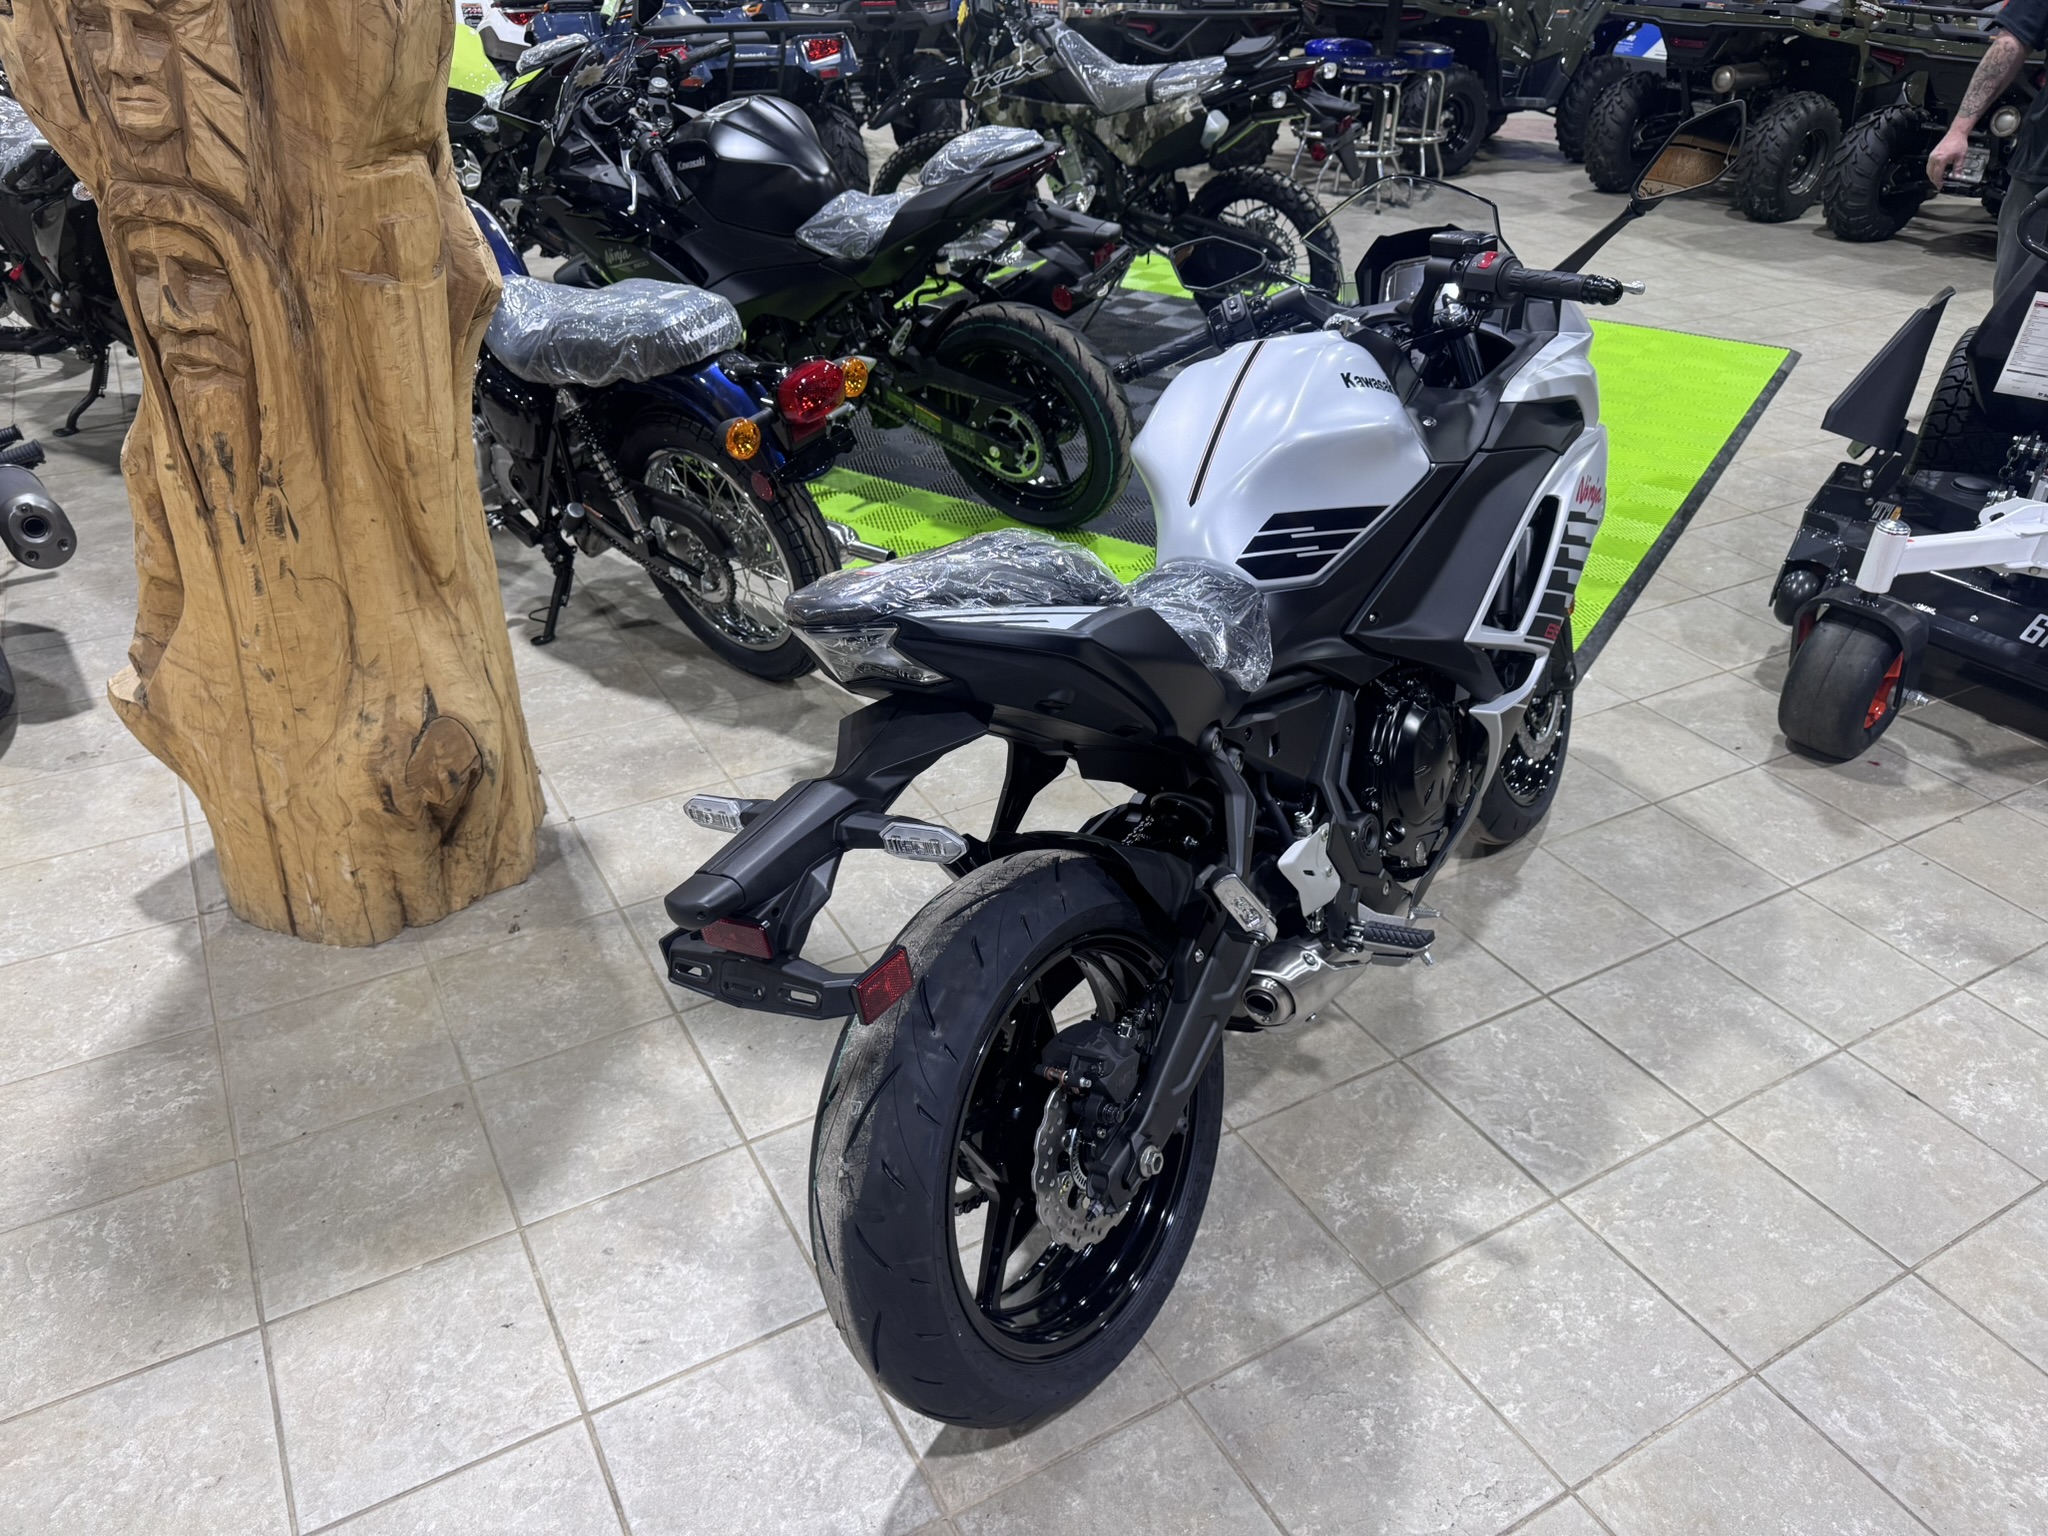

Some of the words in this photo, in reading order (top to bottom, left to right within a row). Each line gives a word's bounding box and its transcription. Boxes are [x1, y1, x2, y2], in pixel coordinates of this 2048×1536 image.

[971, 54, 1048, 97] KLX
[677, 156, 706, 171] Kawasaki
[604, 245, 632, 264] Ninja
[681, 312, 731, 344] Kawasaki
[1575, 474, 1603, 513] Ninja
